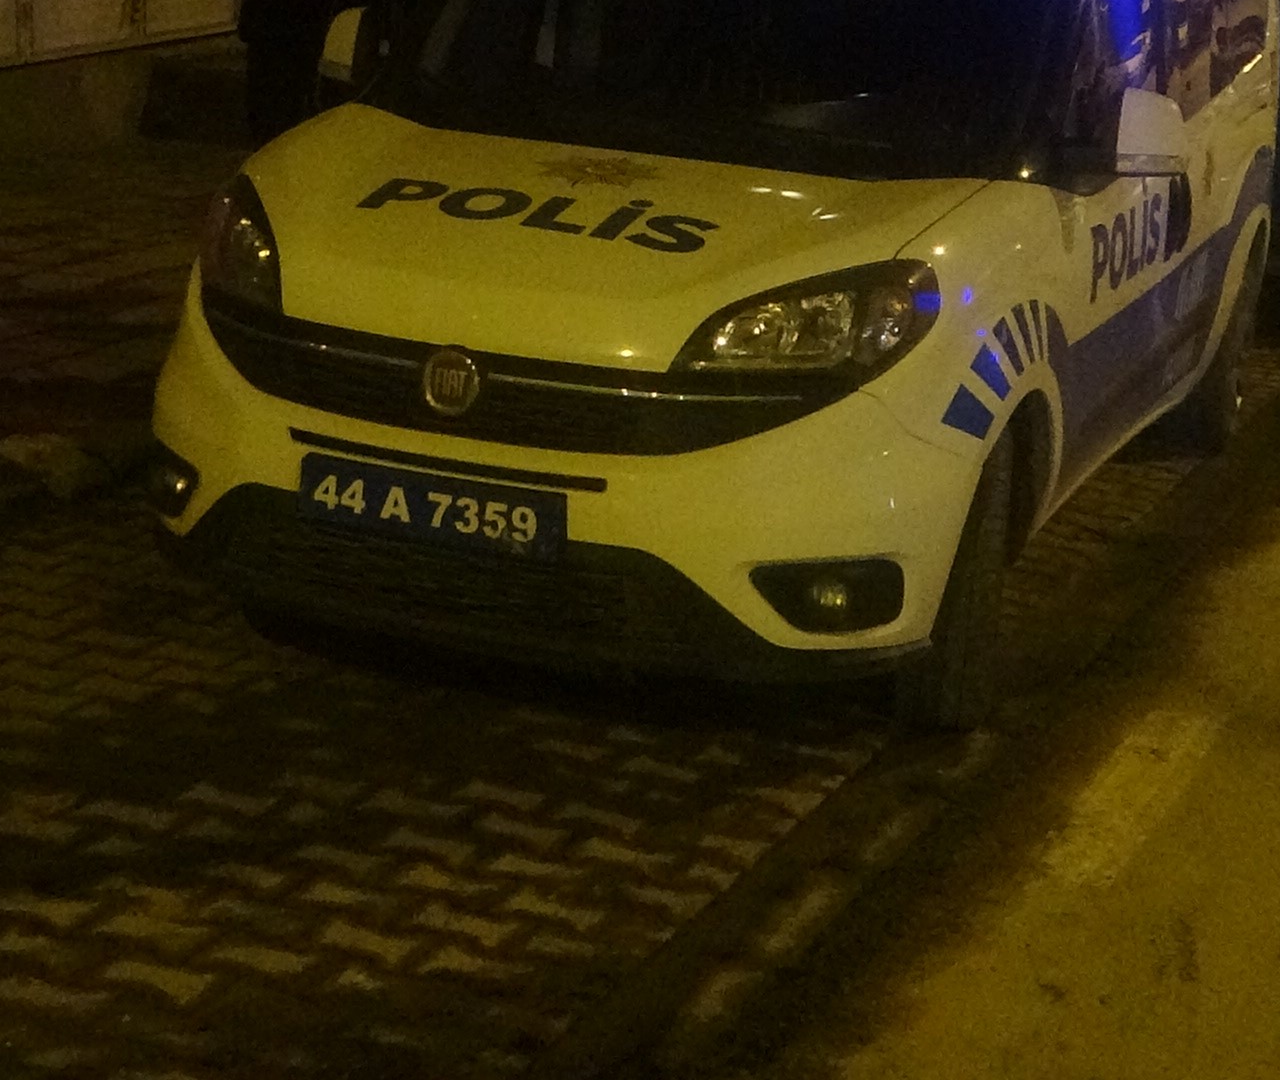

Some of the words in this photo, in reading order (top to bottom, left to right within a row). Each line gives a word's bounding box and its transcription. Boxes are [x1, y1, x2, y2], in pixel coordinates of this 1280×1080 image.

[435, 366, 468, 399] FIAT
[314, 474, 366, 514] 44
[380, 486, 411, 523] A
[428, 491, 537, 542] 7359
